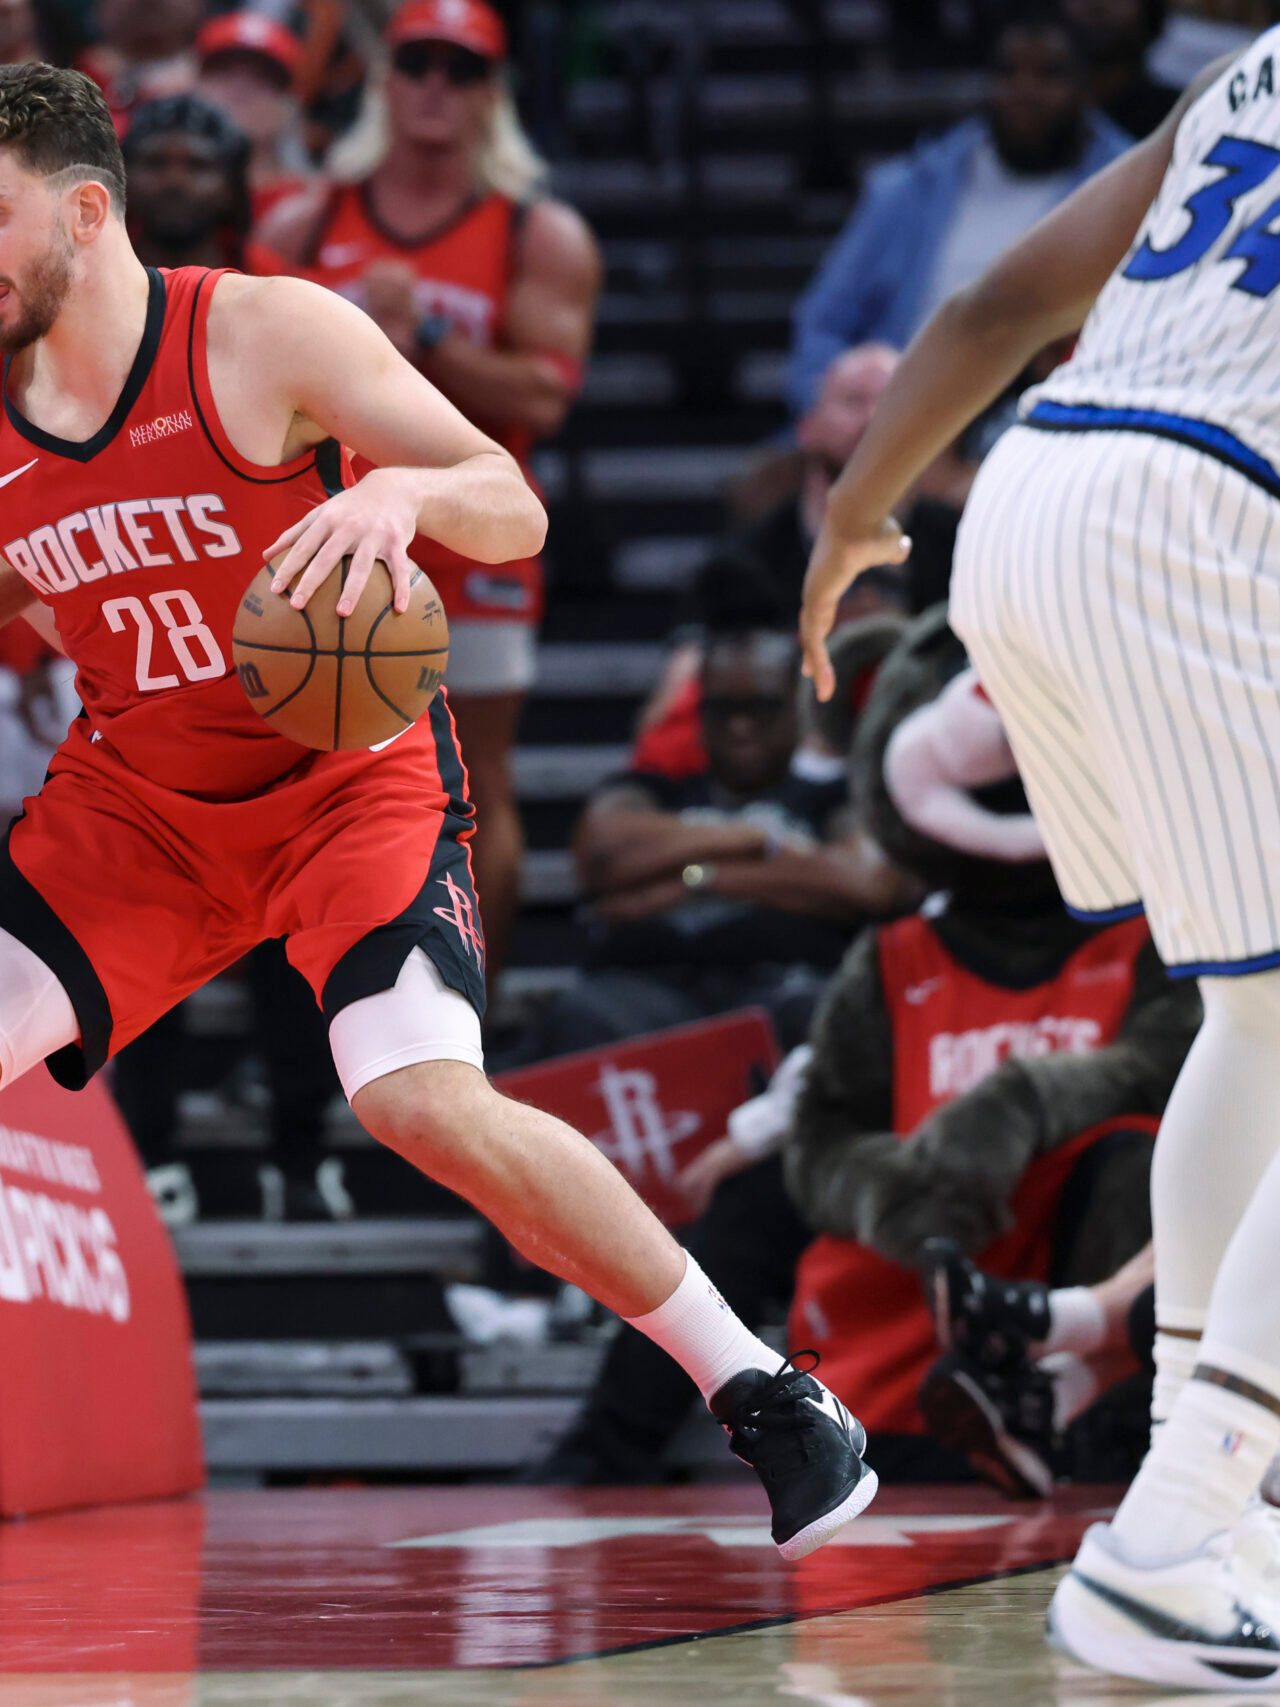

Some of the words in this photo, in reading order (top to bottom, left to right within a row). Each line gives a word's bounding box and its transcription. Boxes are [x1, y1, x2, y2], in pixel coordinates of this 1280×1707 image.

[129, 410, 192, 438] MEMORIAL
[131, 418, 193, 448] HERMANN
[4, 493, 242, 596] ROCKETS
[101, 589, 226, 692] 28
